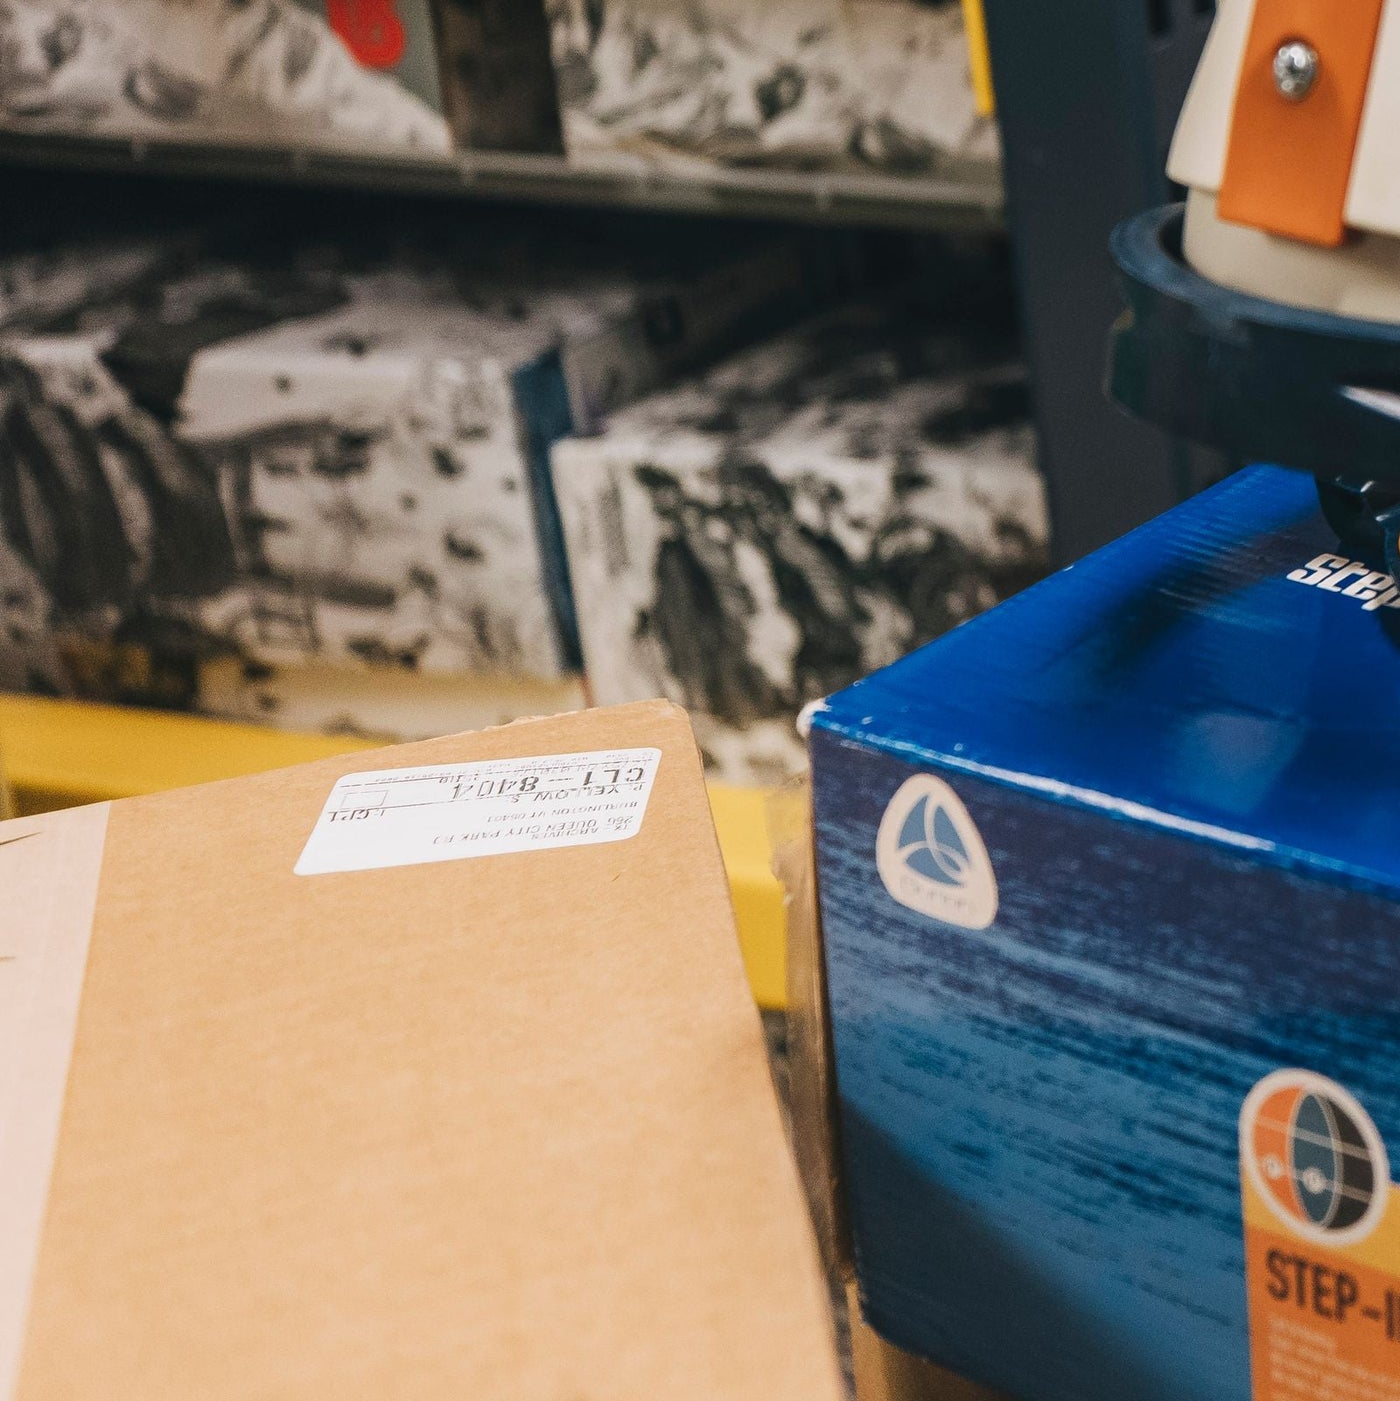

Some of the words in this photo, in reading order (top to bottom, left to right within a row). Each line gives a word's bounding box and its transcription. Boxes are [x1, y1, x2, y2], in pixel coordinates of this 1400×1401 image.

[581, 766, 645, 786] CL1
[448, 775, 540, 799] 8404
[504, 824, 541, 836] CITY
[545, 818, 597, 831] QUEEN
[460, 829, 500, 840] PARK
